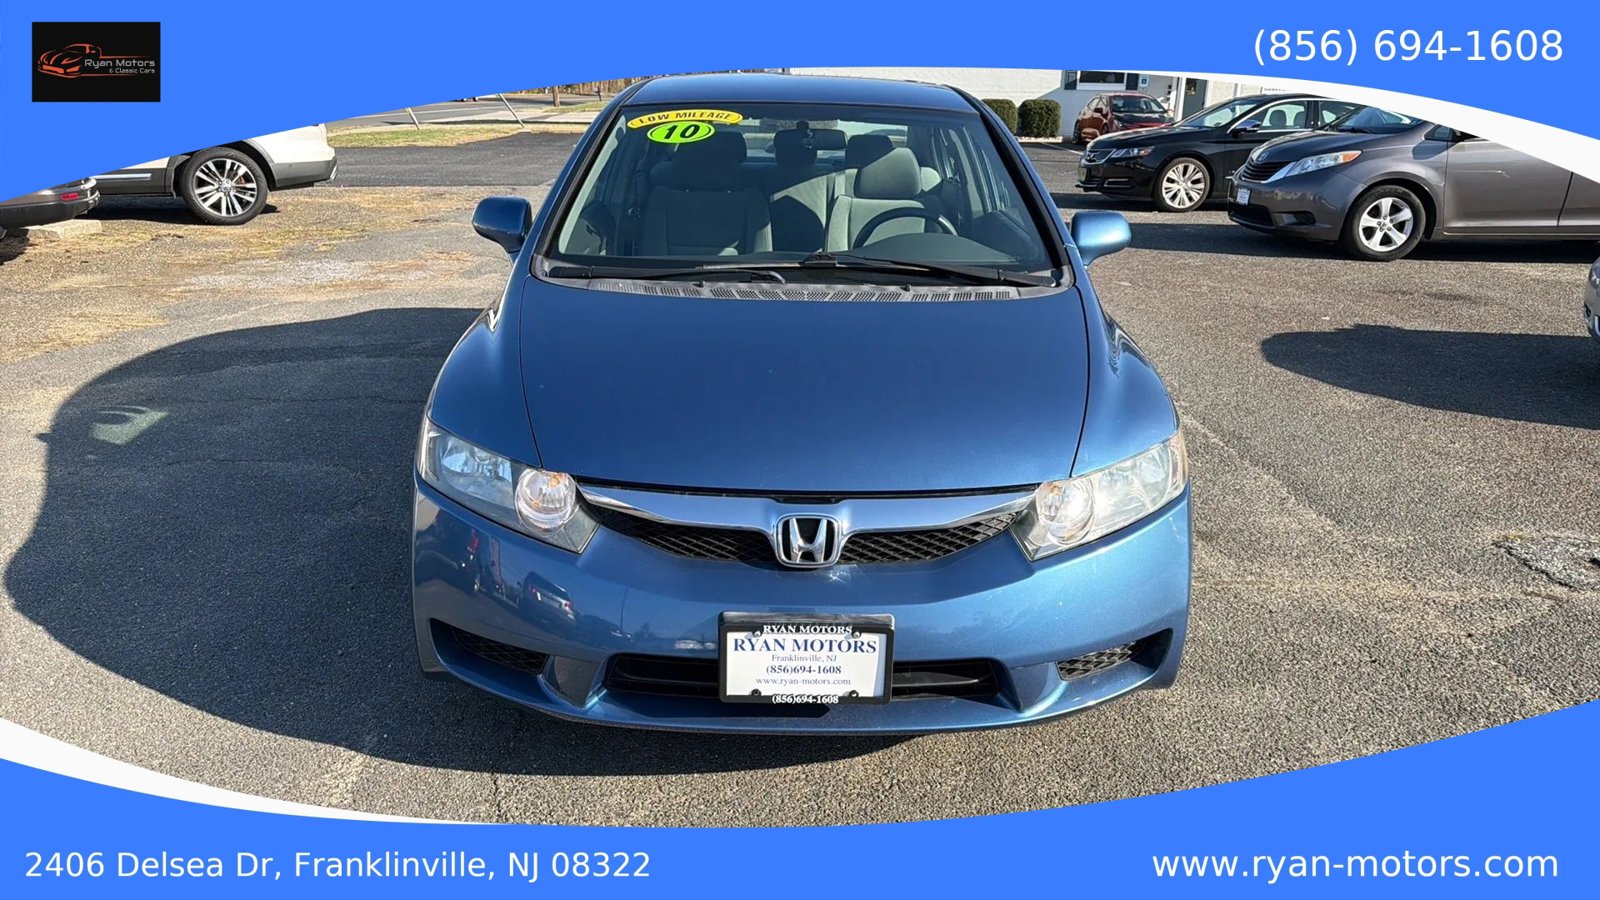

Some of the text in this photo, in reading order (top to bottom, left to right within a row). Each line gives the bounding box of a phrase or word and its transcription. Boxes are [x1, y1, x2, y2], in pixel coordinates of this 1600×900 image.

[639, 111, 733, 124] LOW MILEAGE
[663, 123, 701, 140] 10
[763, 624, 853, 635] RYAN MOTORS
[733, 637, 877, 653] RYAN MOTORS
[771, 653, 838, 664] Franklinville, NJ
[766, 664, 842, 676] (856)694-1608
[755, 676, 851, 686] www.ryan-motors.com
[771, 693, 840, 705] (856)694-1608
